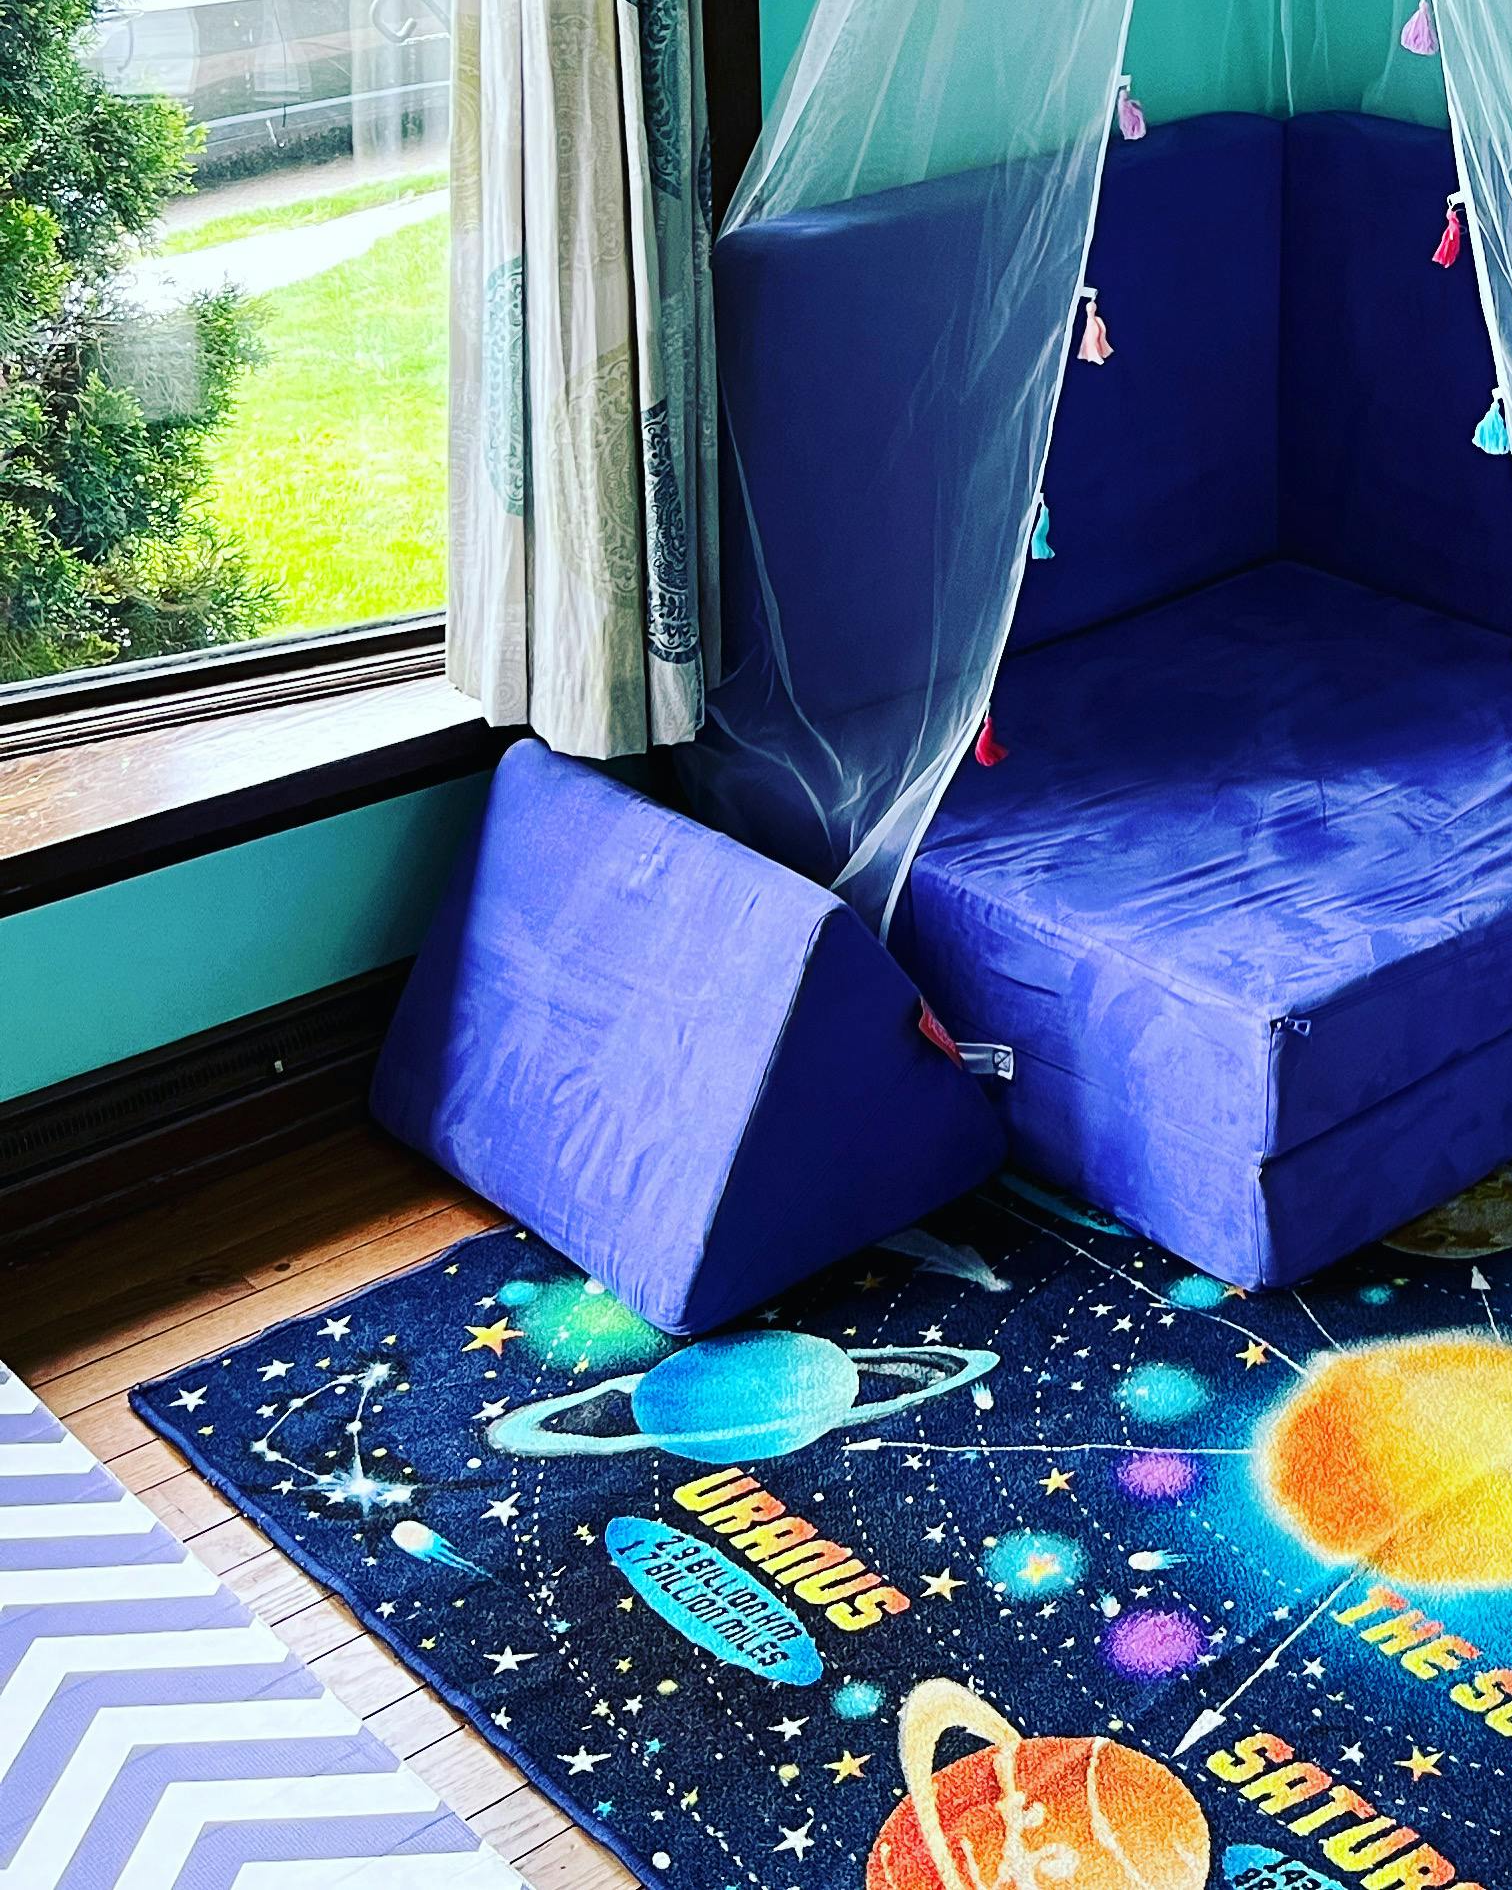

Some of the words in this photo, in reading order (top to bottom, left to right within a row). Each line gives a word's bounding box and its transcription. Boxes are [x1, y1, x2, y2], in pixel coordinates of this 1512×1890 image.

[672, 1466, 912, 1632] URANUS
[685, 1558, 769, 1618] BILLION
[751, 1611, 803, 1642] KM
[643, 1562, 729, 1624] BILLION
[712, 1618, 790, 1666] MILES
[1334, 1585, 1483, 1681] THE
[1205, 1731, 1488, 1890] SATUR
